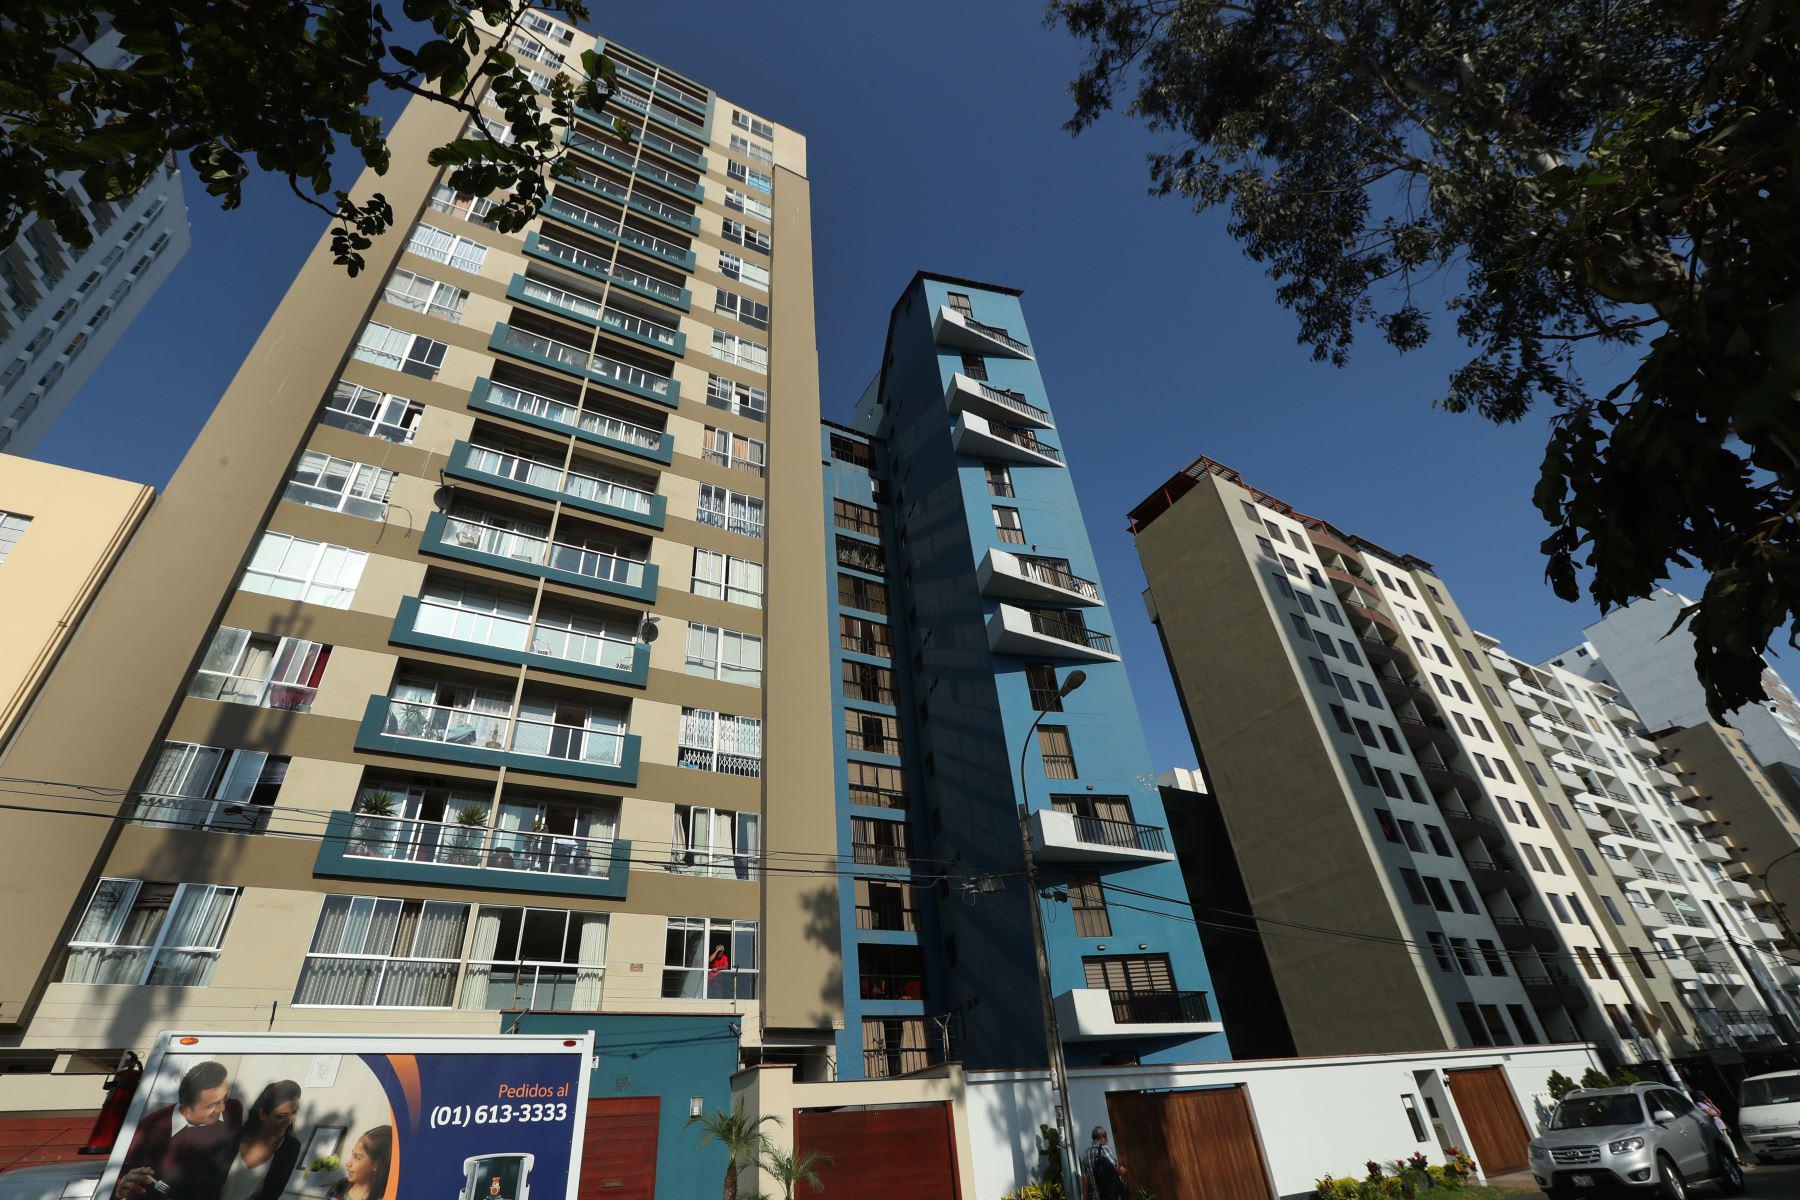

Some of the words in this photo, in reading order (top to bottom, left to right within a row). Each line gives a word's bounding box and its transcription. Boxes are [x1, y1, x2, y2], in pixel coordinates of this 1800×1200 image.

[498, 1084, 553, 1098] Pedidos
[556, 1083, 568, 1096] al
[430, 1105, 471, 1128] (01)
[474, 1103, 567, 1124] 613-3333
